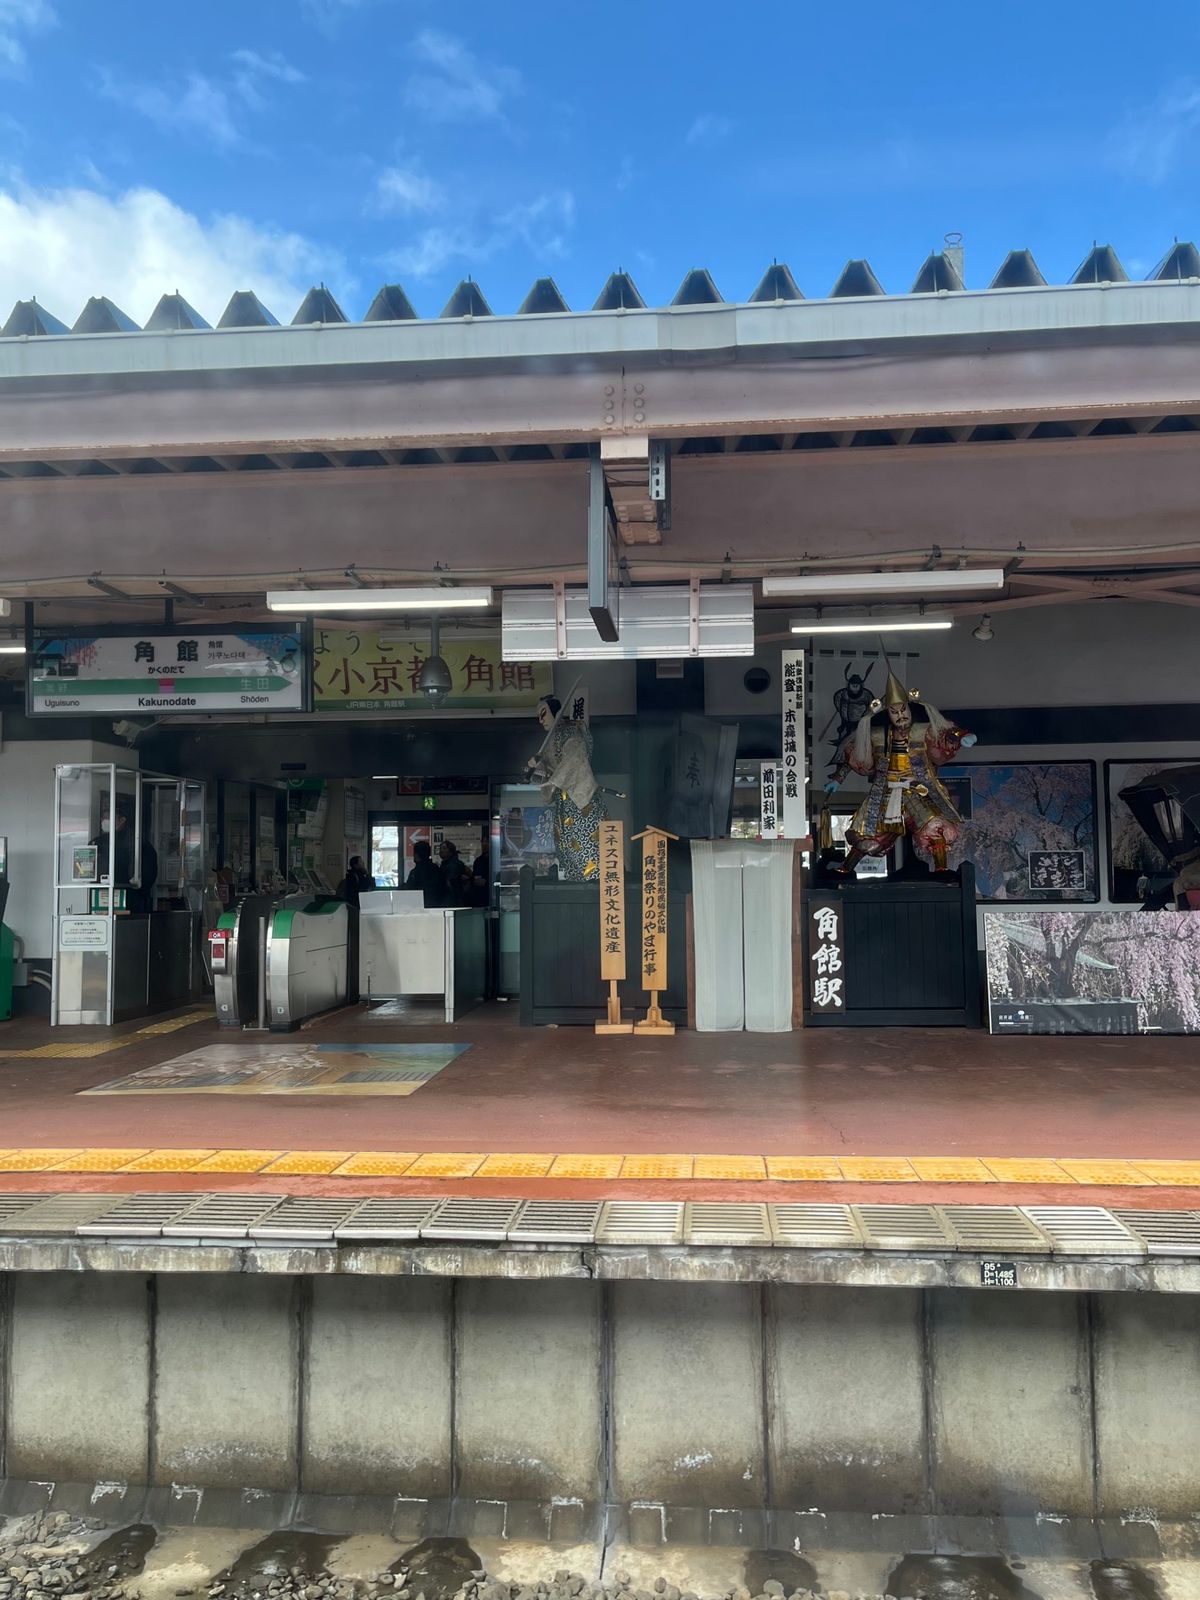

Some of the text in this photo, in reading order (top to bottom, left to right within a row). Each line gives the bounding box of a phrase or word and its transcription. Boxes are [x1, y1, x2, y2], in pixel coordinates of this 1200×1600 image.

[134, 640, 199, 663] 角館
[148, 665, 185, 675] かくのだて
[240, 678, 269, 690] 生田
[45, 697, 80, 708] Uguisuno
[138, 696, 197, 707] Kakunodate
[240, 694, 270, 704] Shōden
[762, 768, 775, 830] 前田利家
[604, 825, 621, 953] ユネスコ無形文化遺産
[643, 855, 657, 976] 角館祭りのやま行事
[811, 906, 843, 1008] 角館駅
